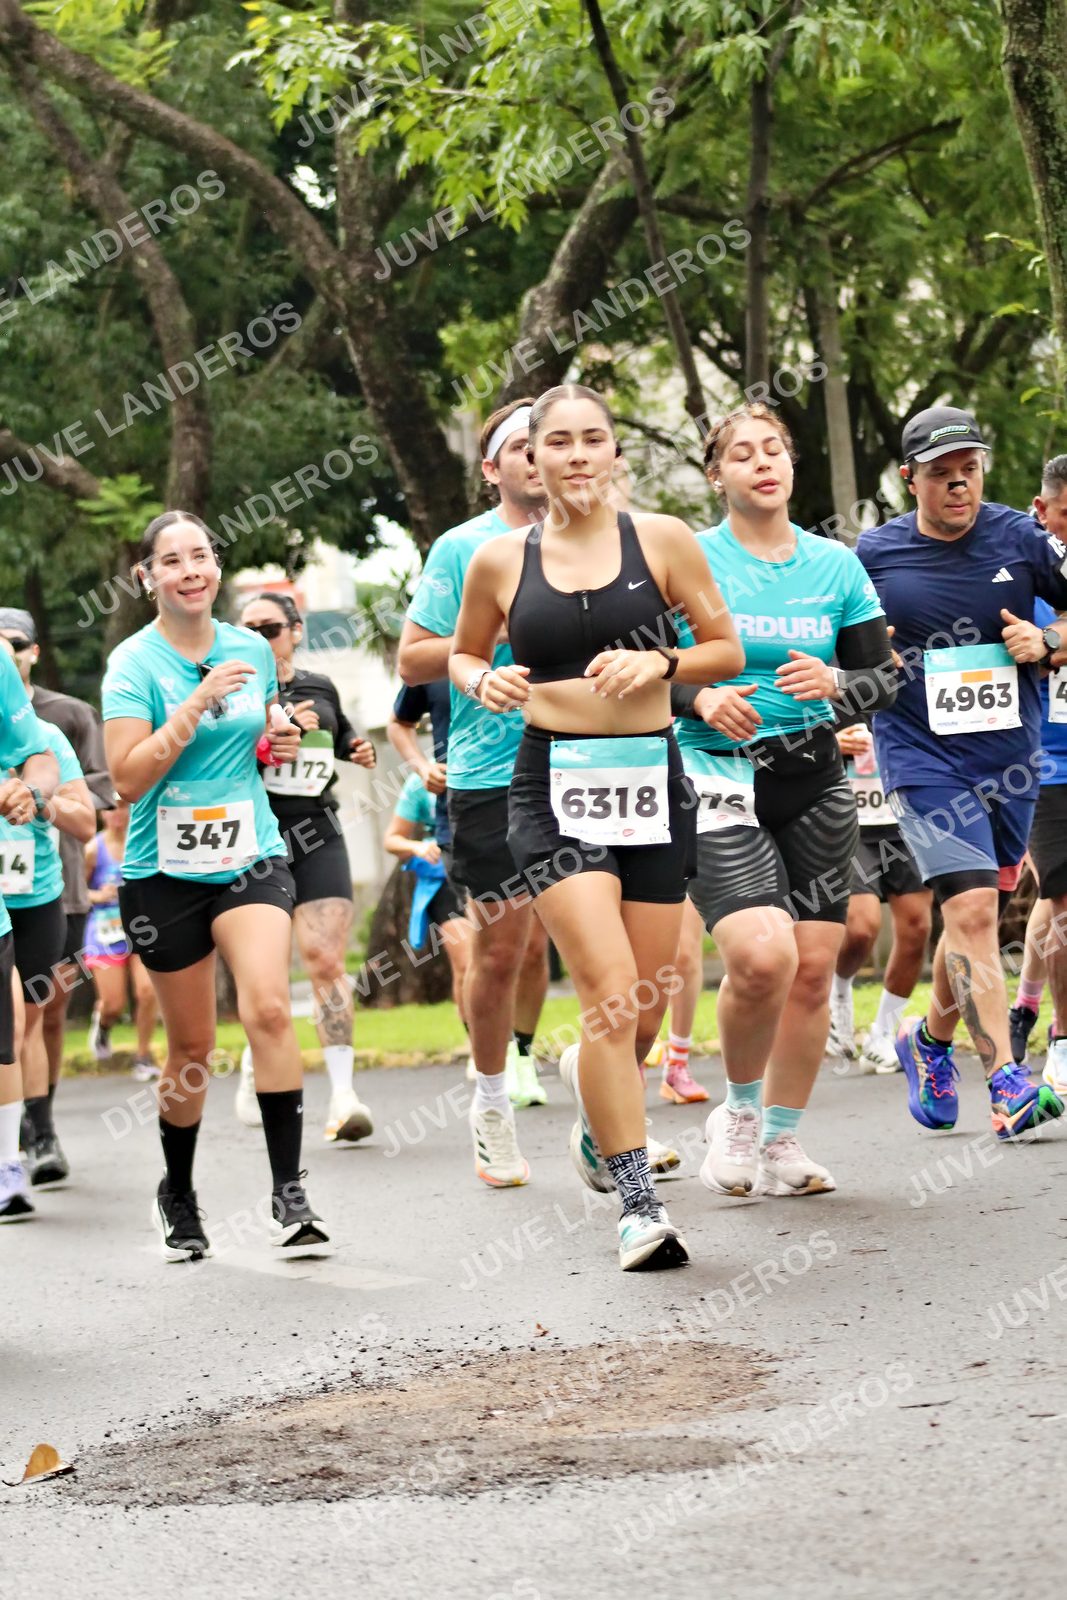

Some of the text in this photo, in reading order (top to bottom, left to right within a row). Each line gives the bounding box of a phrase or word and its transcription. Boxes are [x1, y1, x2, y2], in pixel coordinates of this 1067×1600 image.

[936, 683, 1012, 712] 4963
[561, 786, 658, 819] 6318
[176, 819, 241, 851] 347
